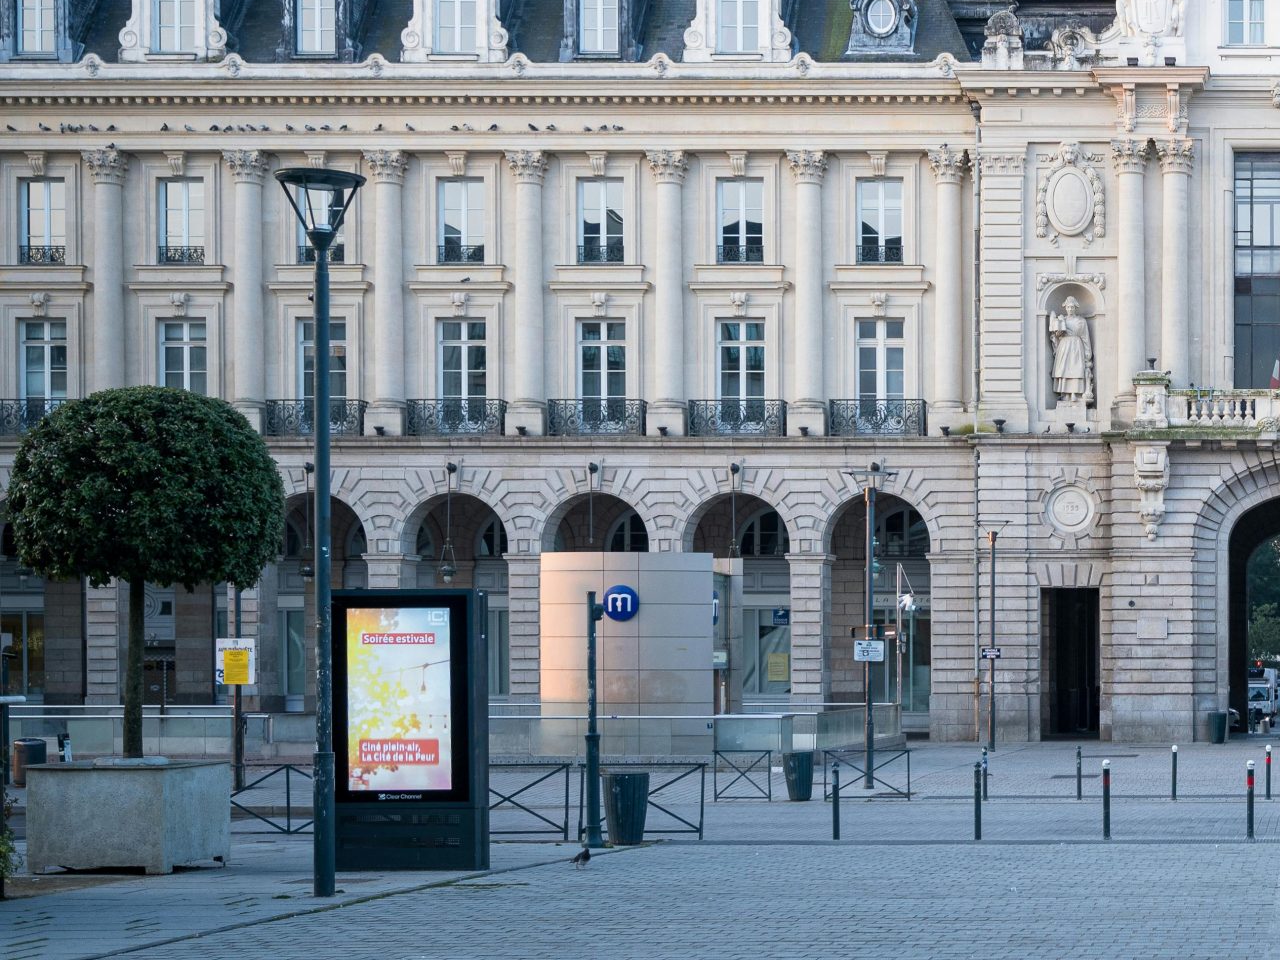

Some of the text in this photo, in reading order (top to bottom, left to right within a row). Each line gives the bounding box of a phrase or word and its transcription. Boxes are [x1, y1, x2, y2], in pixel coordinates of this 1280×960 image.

[363, 633, 434, 643] Soirée estivale
[362, 741, 421, 753] Ciné plein-air,
[362, 752, 435, 761] La Cité de la Peur
